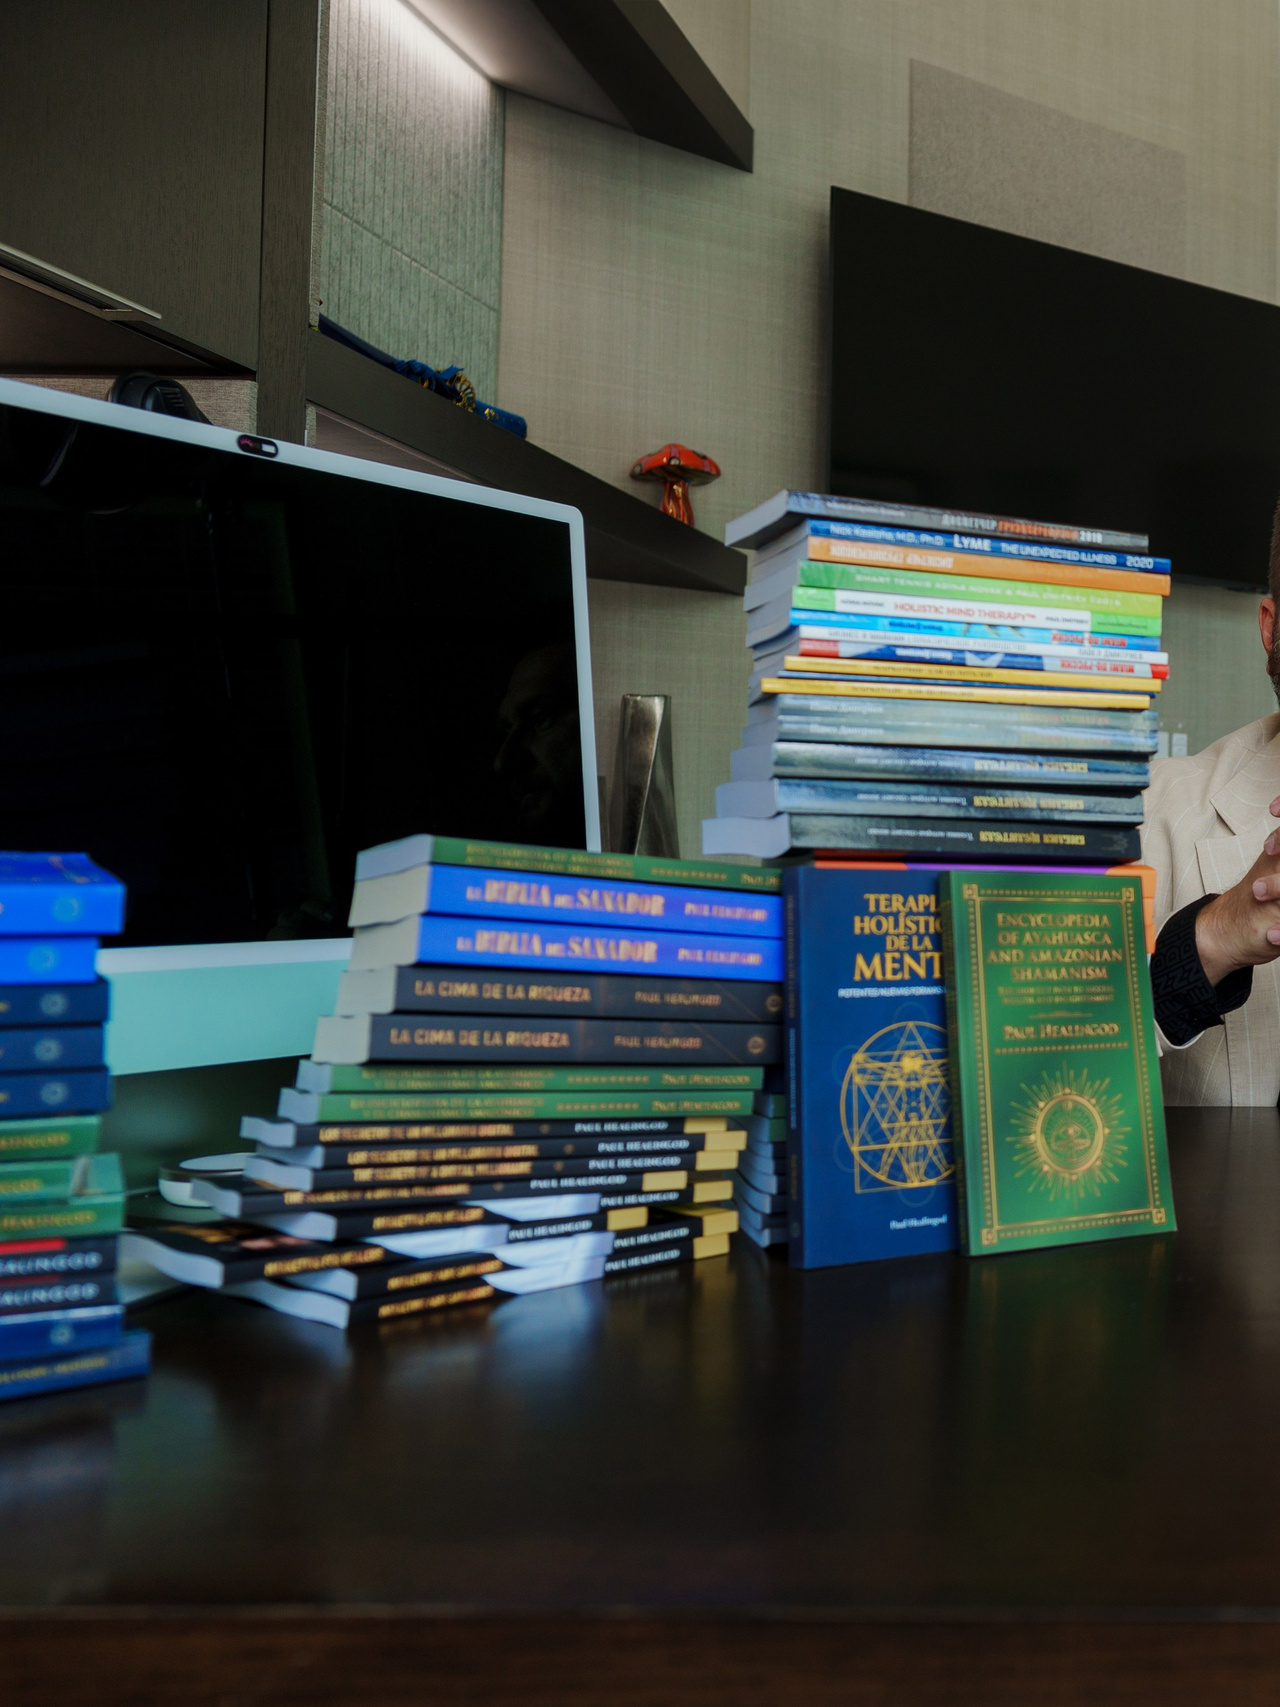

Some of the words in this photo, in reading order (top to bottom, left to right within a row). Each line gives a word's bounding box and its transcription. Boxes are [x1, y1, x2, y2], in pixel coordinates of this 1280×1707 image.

[1018, 544, 1080, 562] UNEXPECTED
[1126, 556, 1154, 569] 2020
[893, 601, 944, 616] HOLISTIC
[946, 606, 975, 618] MIND
[864, 893, 936, 913] TERAPI
[996, 912, 1111, 928] ENCYCLOPEDIA
[885, 935, 910, 951] DE
[912, 935, 933, 951] LA
[997, 931, 1019, 946] OF
[1022, 931, 1113, 946] AYAHUASCA
[987, 948, 1025, 963] AND
[1028, 948, 1122, 963] AMAZONIAN
[853, 952, 942, 981] MENT
[1010, 966, 1109, 981] SHAMANISM
[414, 979, 435, 997] LA
[438, 981, 479, 998] CIMA
[482, 982, 503, 999] DE
[506, 984, 527, 1000] LA
[528, 984, 592, 1003] RIQUEZA
[389, 1027, 411, 1045] LA
[413, 1028, 456, 1046] CIMA
[458, 1029, 480, 1047] DE
[483, 1030, 504, 1047] LA
[505, 1030, 571, 1049] RIQUEZA
